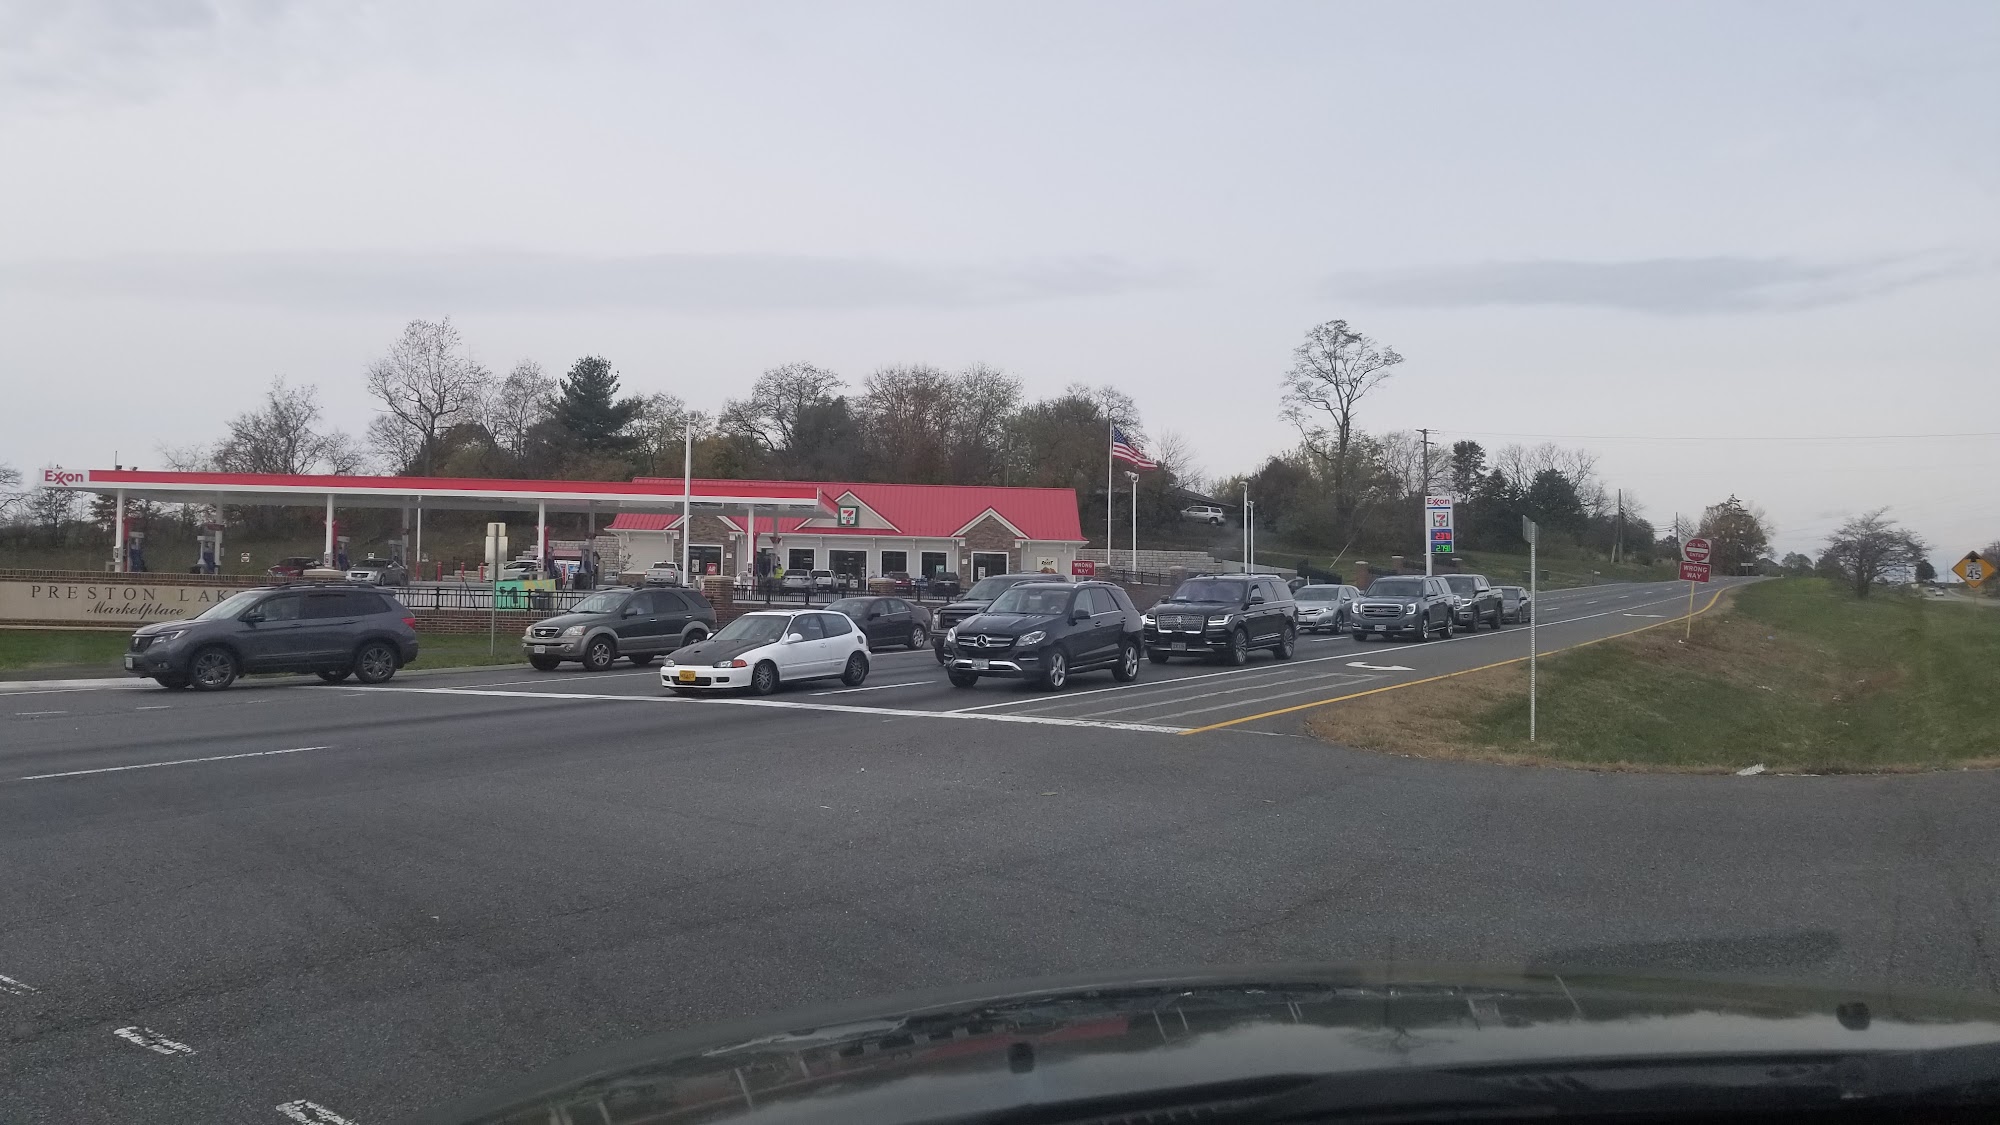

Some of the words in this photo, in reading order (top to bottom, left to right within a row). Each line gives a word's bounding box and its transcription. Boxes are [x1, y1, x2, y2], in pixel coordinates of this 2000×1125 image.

[45, 469, 84, 486] Exxon
[1427, 497, 1451, 506] Exxon
[1684, 565, 1709, 574] WRONG
[1967, 570, 1982, 580] 45
[31, 585, 156, 602] PRESTON
[179, 588, 246, 603] LAK
[86, 601, 187, 620] Marketplace
